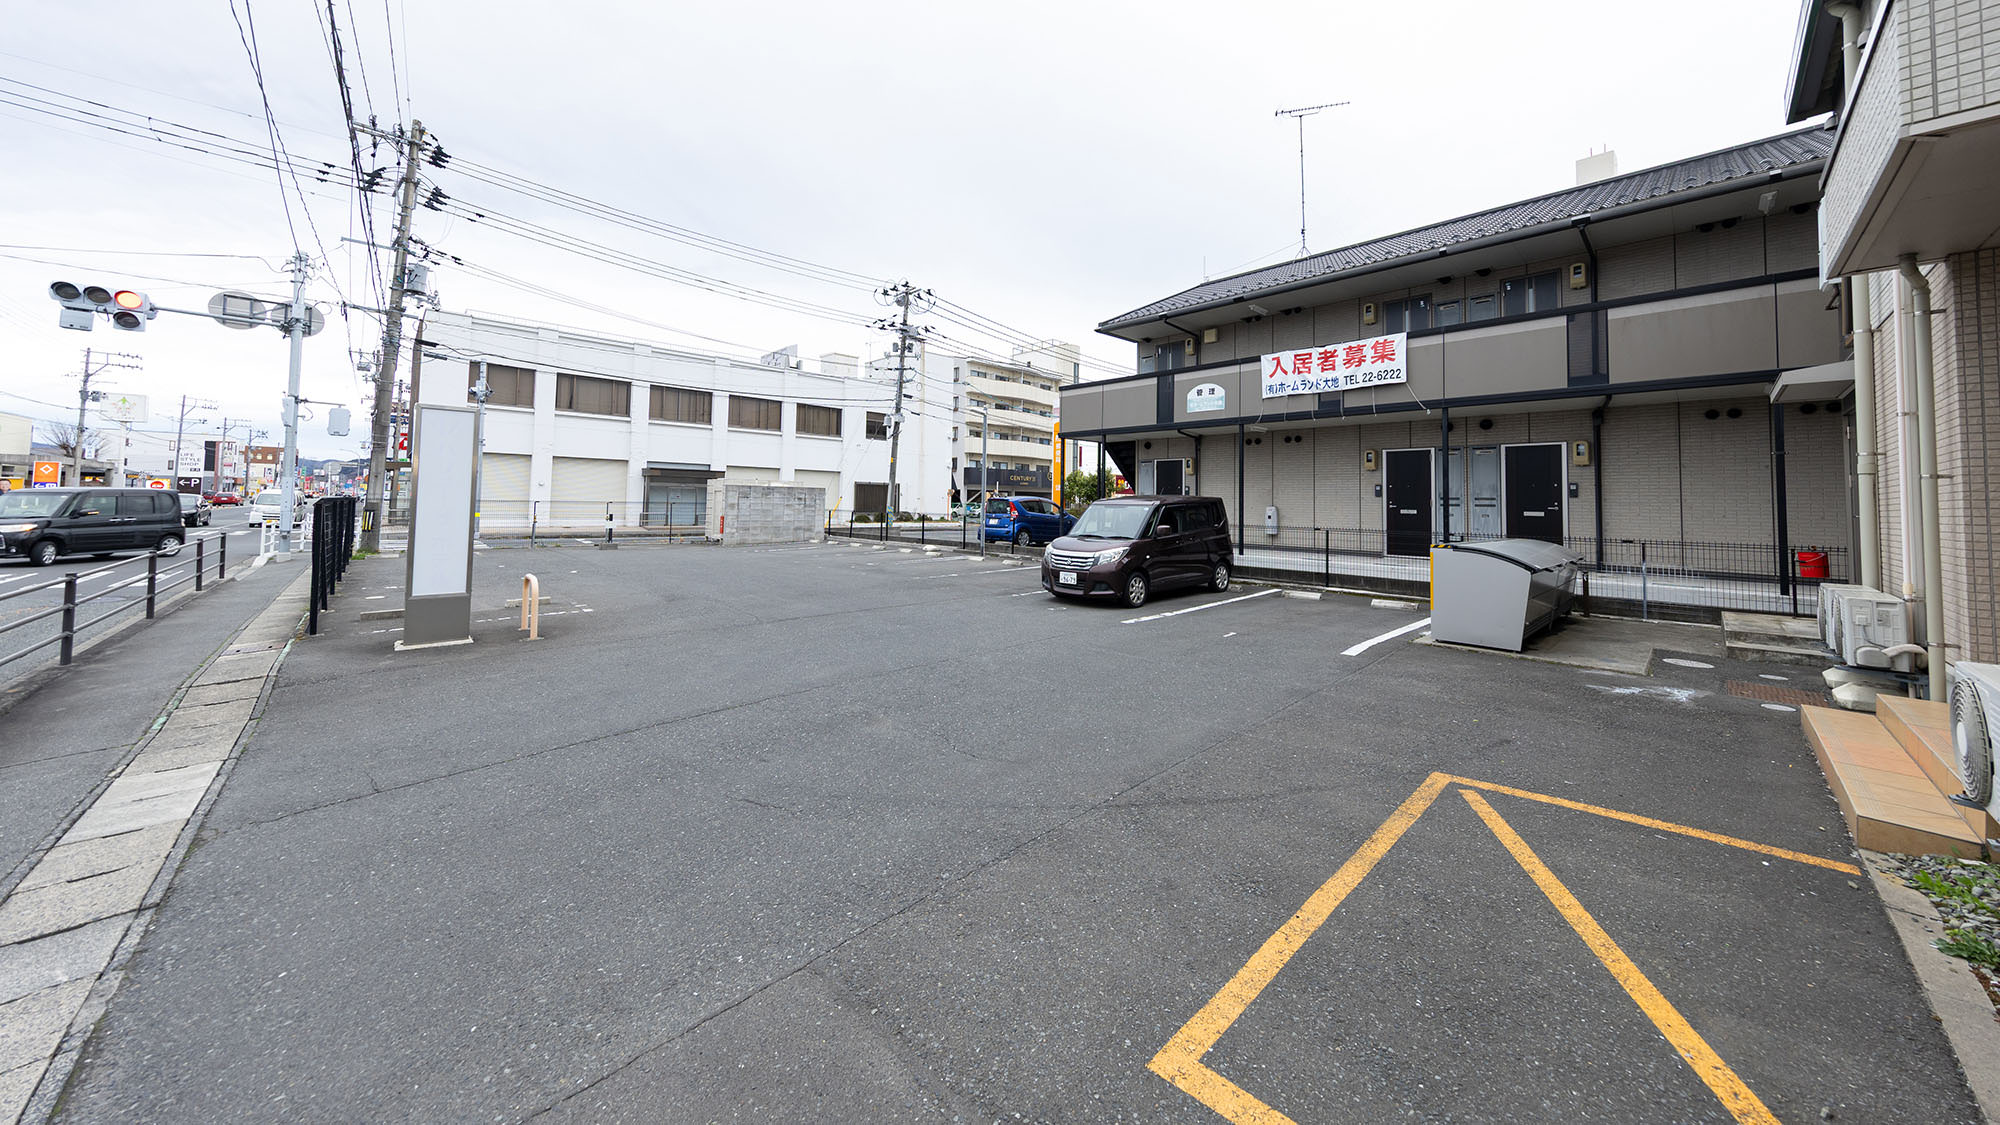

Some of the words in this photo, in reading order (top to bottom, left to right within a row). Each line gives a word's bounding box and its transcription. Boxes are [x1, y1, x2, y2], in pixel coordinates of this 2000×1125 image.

[1268, 339, 1396, 378] 入居者募集
[1344, 375, 1360, 386] TEL
[1362, 368, 1402, 383] 22-6222
[191, 478, 200, 488] P
